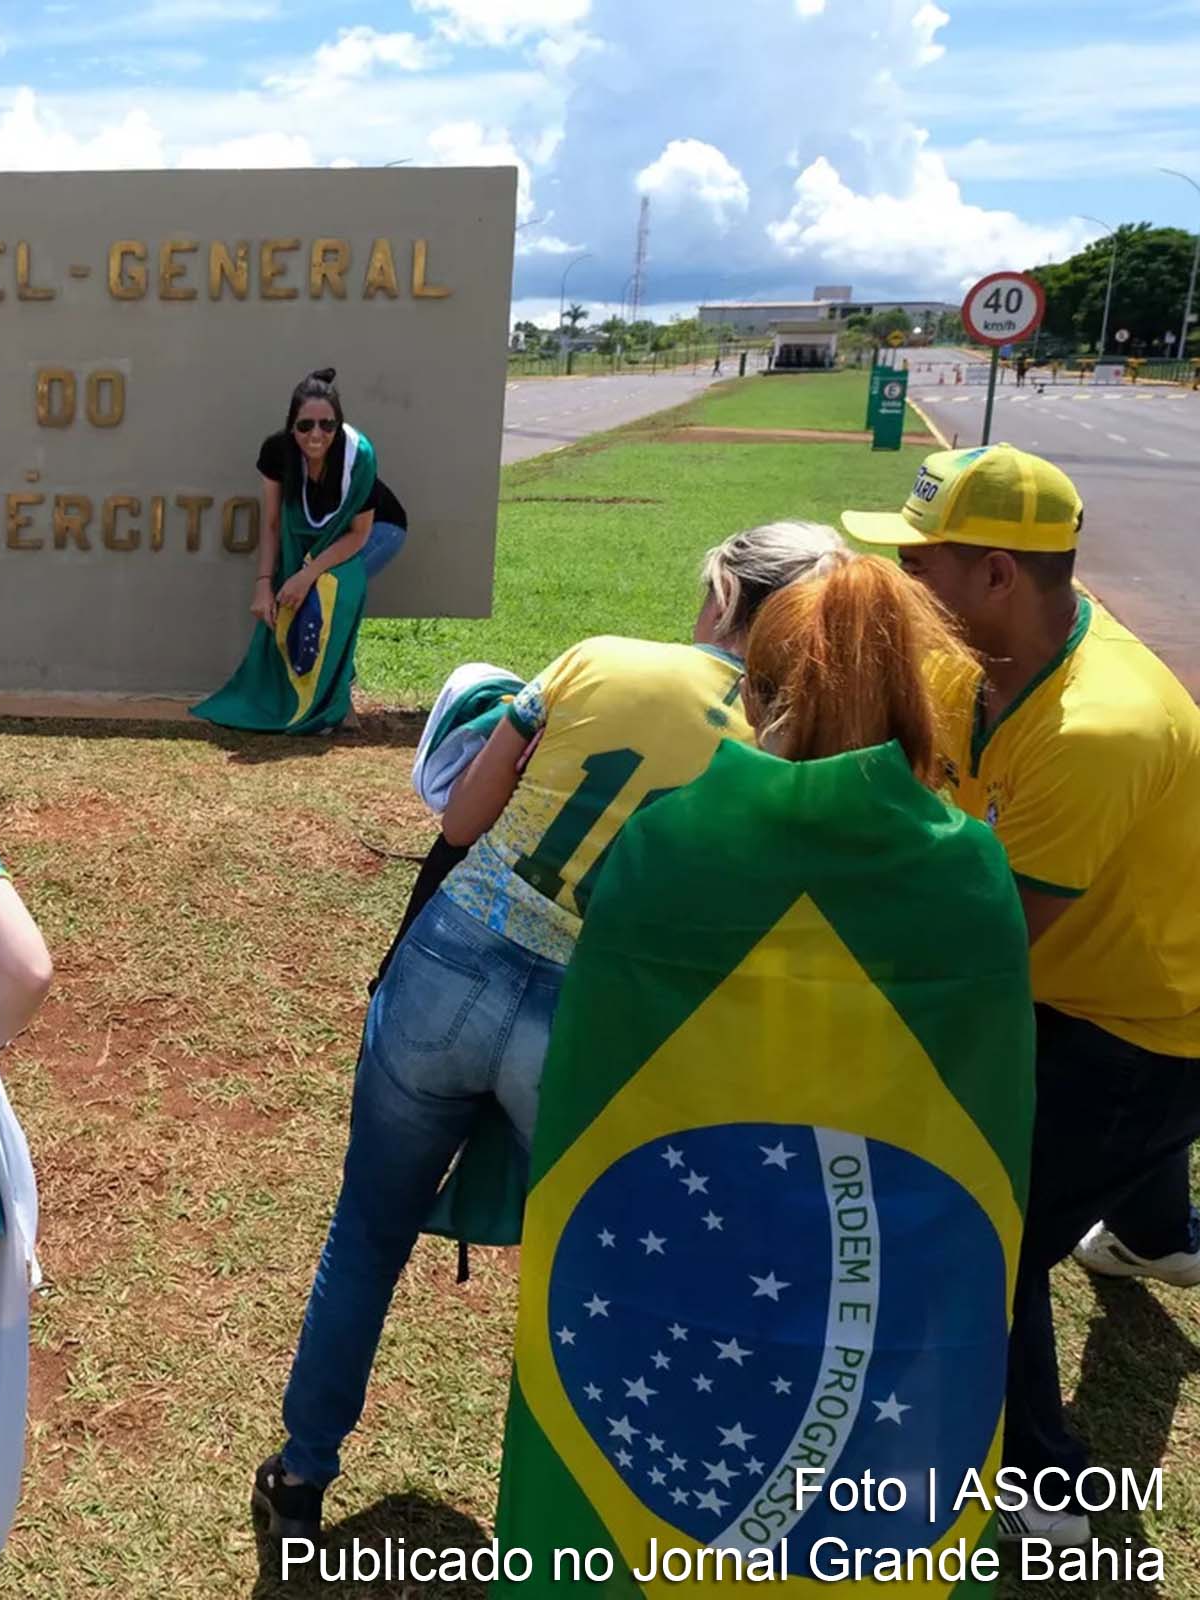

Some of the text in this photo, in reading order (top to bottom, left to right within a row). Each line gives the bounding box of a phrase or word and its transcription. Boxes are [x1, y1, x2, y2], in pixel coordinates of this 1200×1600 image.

[983, 287, 1023, 314] 40
[983, 320, 1017, 331] km/h
[36, 368, 126, 429] DO
[829, 1156, 871, 1283] ORDEM
[839, 1302, 871, 1323] E
